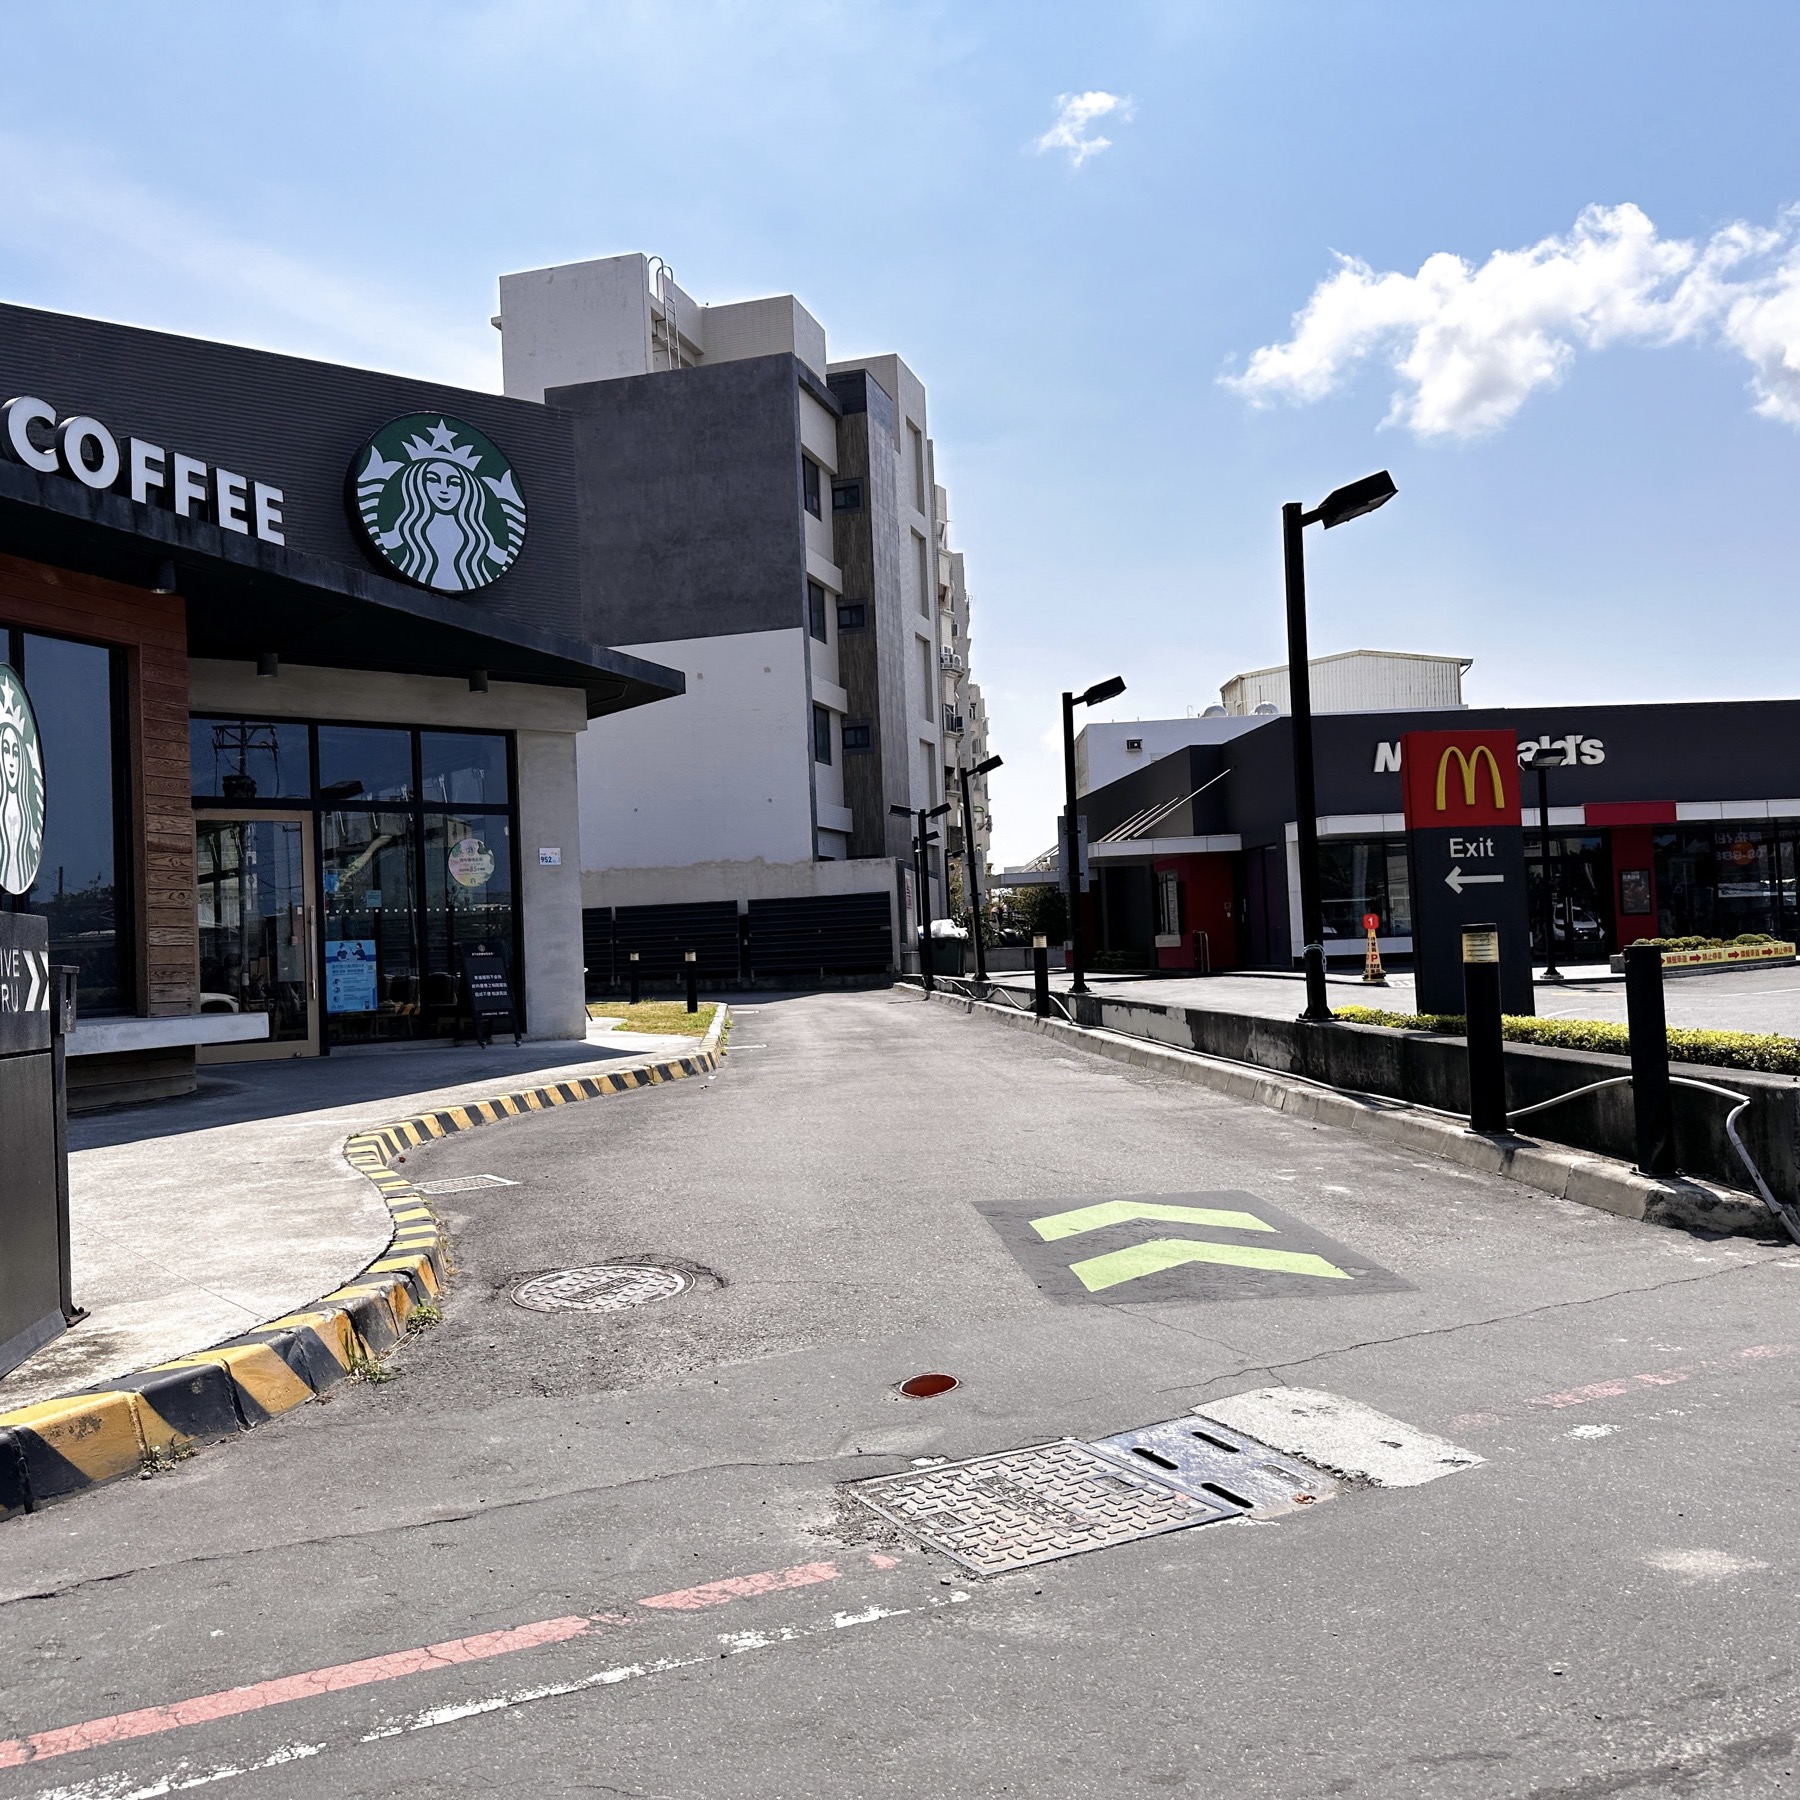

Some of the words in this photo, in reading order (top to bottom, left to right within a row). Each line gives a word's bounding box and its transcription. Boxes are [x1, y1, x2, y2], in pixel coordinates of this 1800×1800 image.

[2, 395, 286, 547] COFFEE
[1449, 837, 1495, 858] Exit
[540, 855, 552, 863] 952
[1367, 916, 1374, 926] 1
[1370, 954, 1379, 963] P
